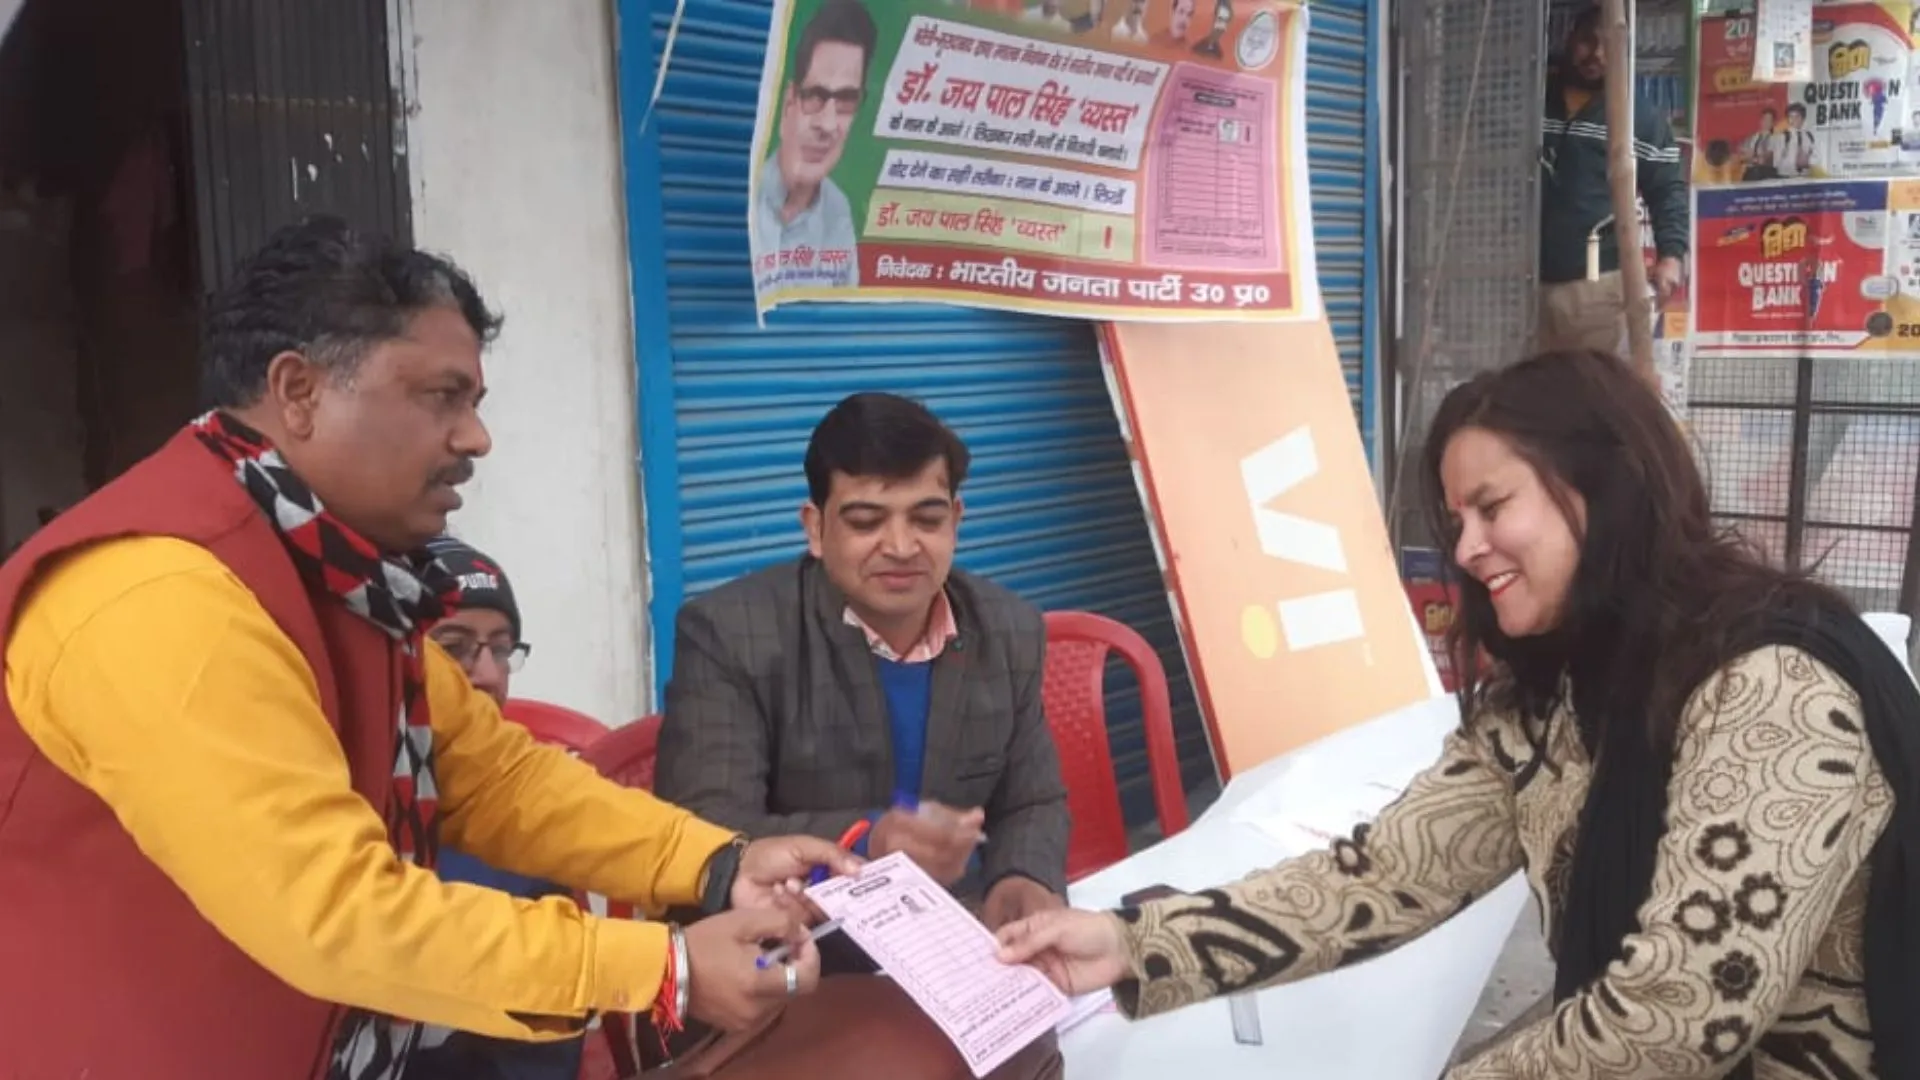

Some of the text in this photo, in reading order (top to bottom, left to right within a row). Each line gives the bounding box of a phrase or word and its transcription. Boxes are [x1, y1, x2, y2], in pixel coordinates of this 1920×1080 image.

[896, 60, 939, 106] डॉ.
[940, 76, 985, 114] जय
[986, 83, 1032, 120] पाल
[1030, 79, 1075, 127] सिंह
[1816, 101, 1862, 125] BANK
[877, 202, 900, 227] डॉ.
[906, 208, 935, 227] जय
[939, 210, 970, 231] पाल
[974, 208, 1005, 236] सिंह
[876, 254, 934, 279] निवेदक
[949, 256, 1037, 290] भारतीय
[1042, 270, 1121, 298] जनता
[1128, 274, 1182, 302] पार्टी
[1752, 284, 1802, 311] BANK
